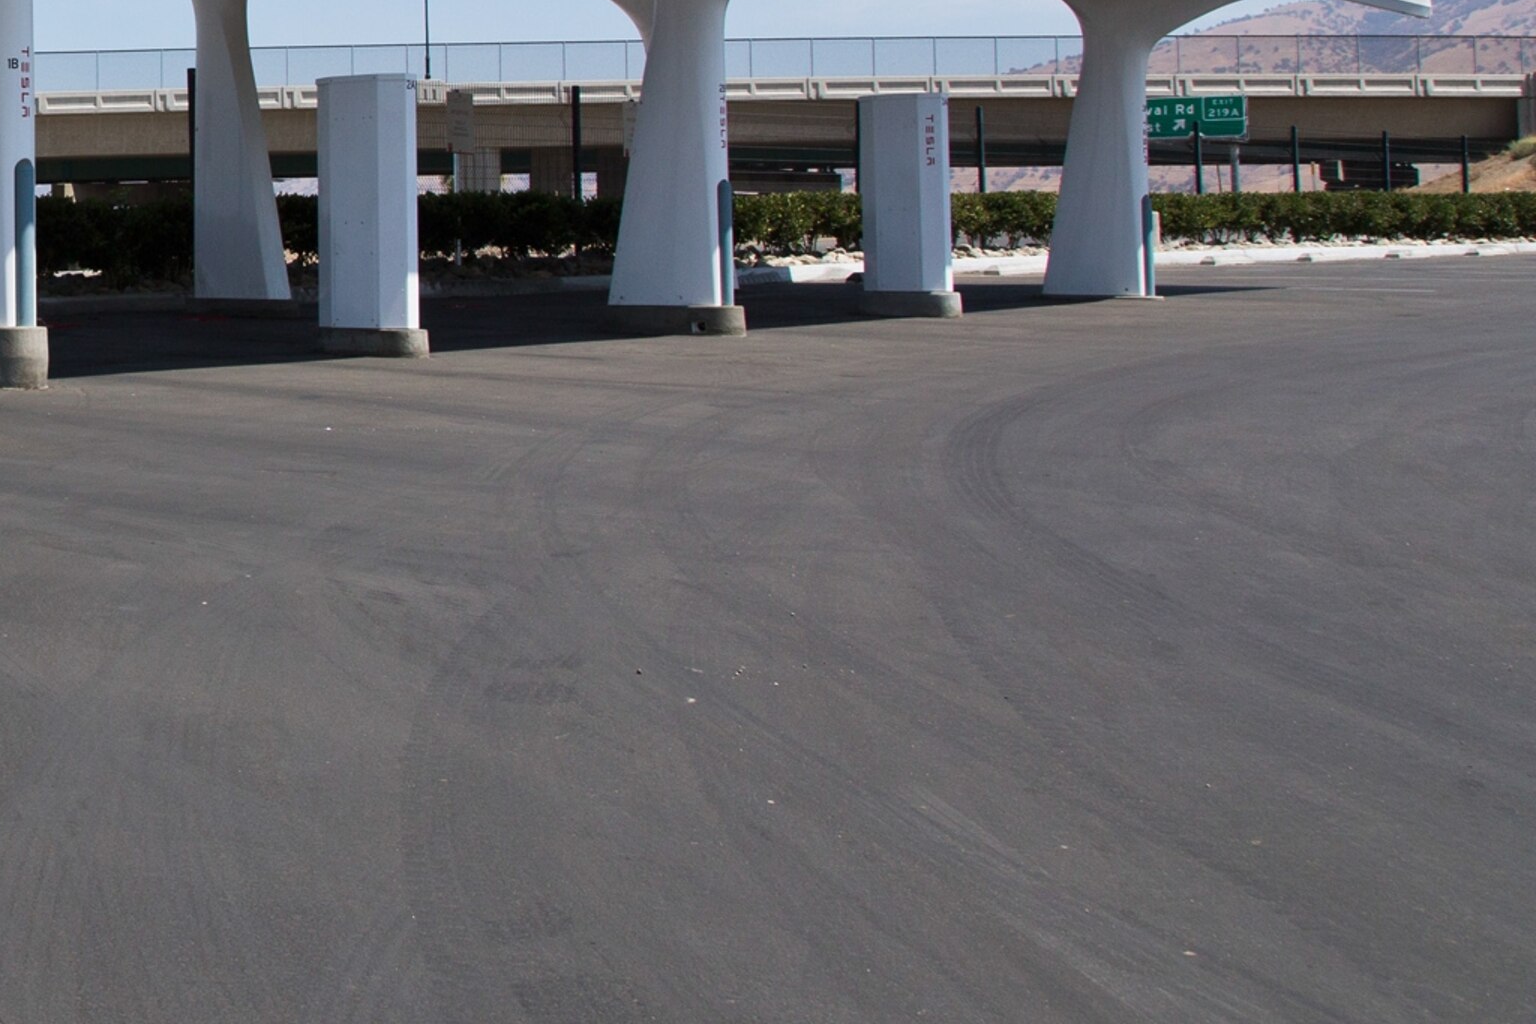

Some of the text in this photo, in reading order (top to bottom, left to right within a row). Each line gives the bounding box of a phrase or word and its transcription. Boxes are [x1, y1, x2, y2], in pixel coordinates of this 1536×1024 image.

[7, 58, 19, 69] 1B
[21, 46, 30, 118] TESLA
[1175, 104, 1194, 115] Rd
[1208, 108, 1239, 117] 219A
[925, 114, 935, 166] TESLA
